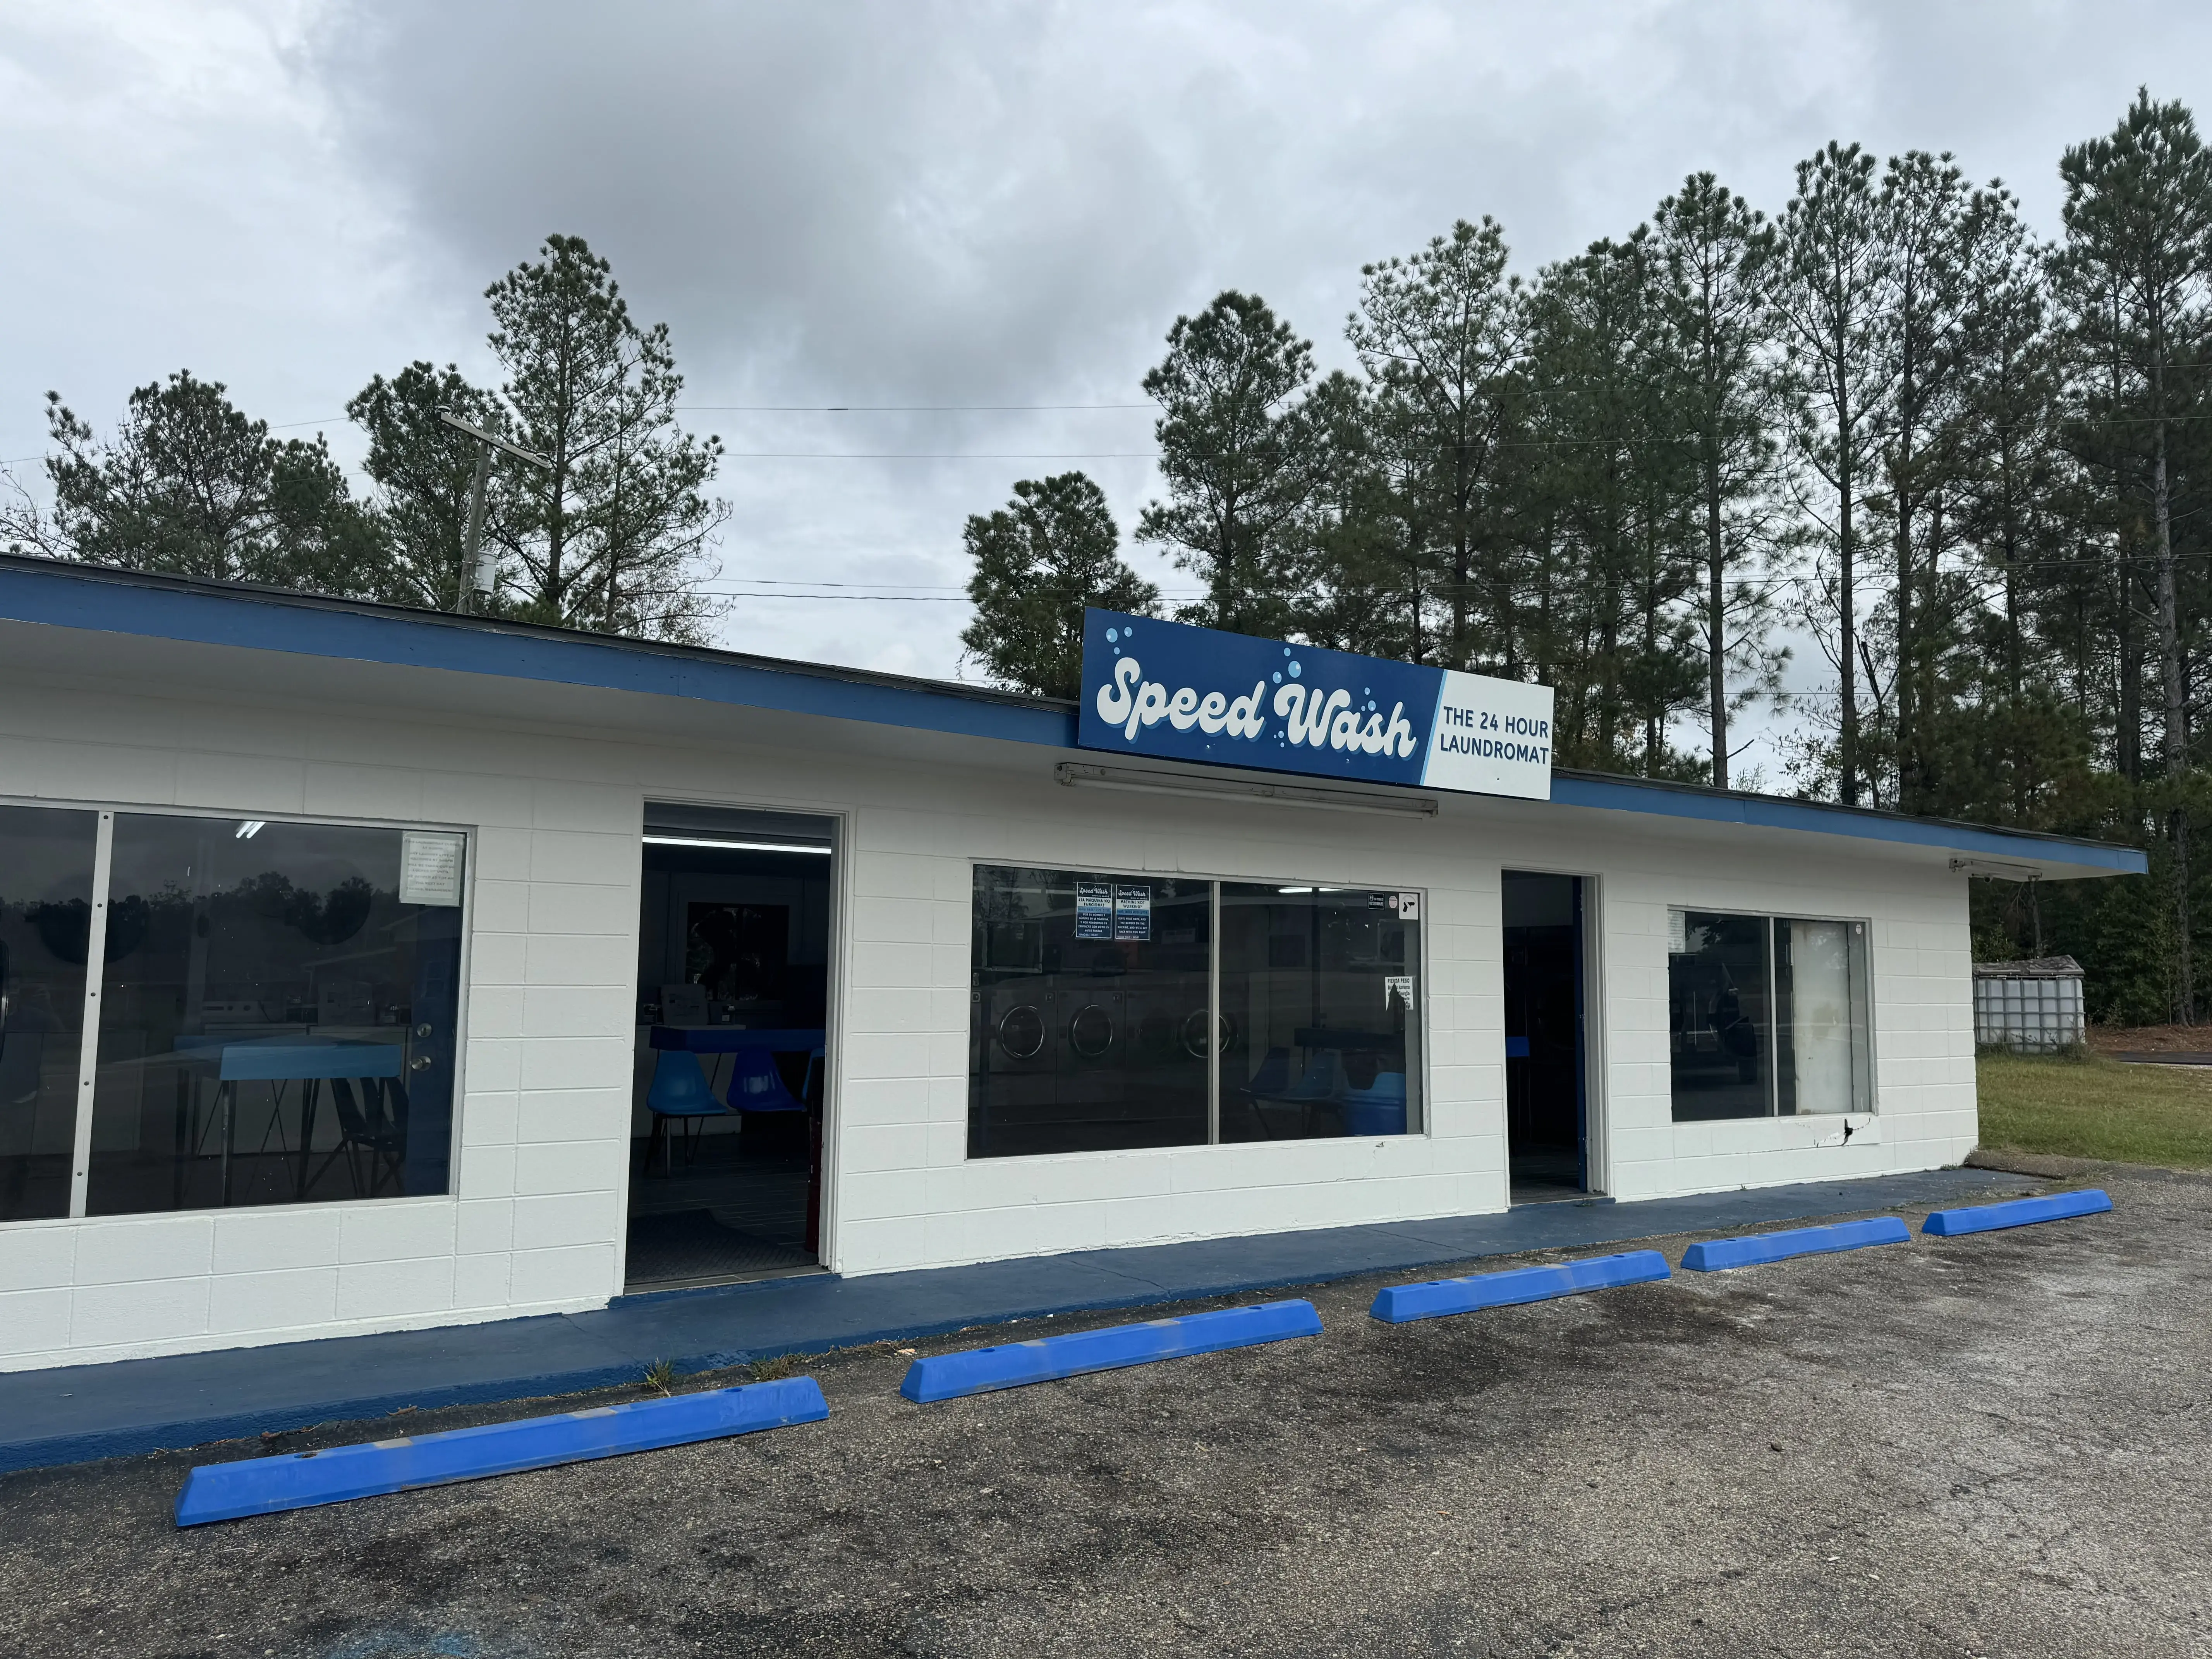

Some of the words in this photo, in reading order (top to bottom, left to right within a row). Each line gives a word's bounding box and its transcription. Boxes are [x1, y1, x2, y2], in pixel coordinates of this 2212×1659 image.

[1097, 657, 1266, 742] Speed
[1273, 684, 1418, 759] Wash
[1443, 706, 1474, 728] THE
[1480, 712, 1498, 731] 24
[1505, 716, 1548, 738] HOUR
[1441, 733, 1549, 764] LAUNDROMAT
[1079, 887, 1094, 895] Speed
